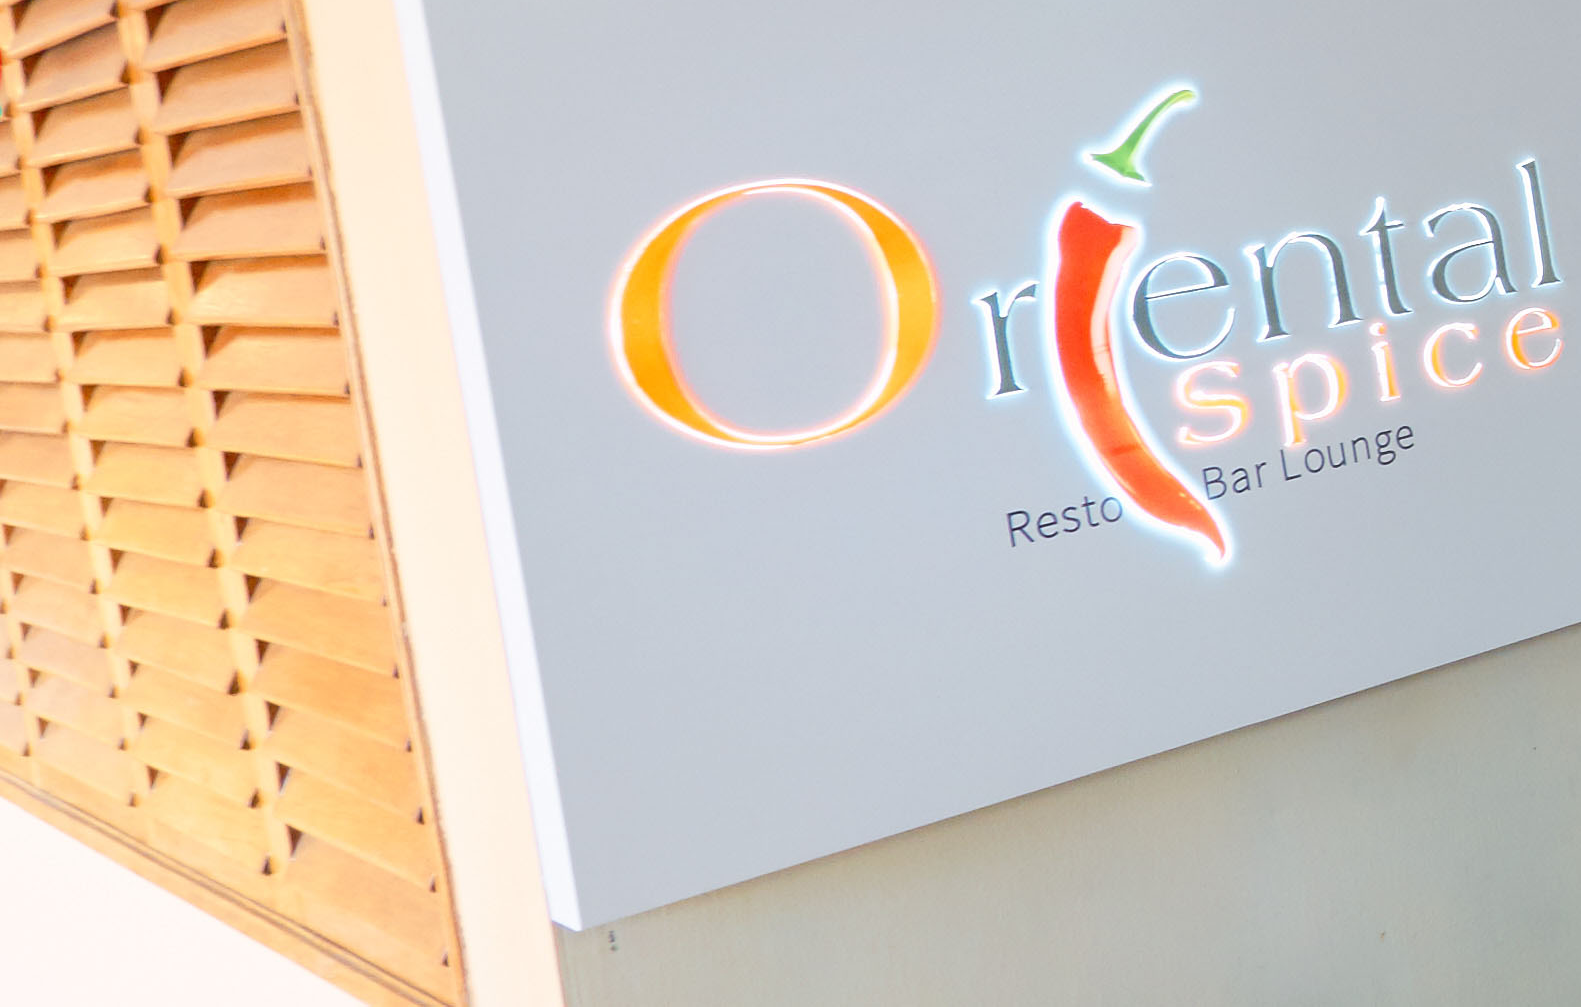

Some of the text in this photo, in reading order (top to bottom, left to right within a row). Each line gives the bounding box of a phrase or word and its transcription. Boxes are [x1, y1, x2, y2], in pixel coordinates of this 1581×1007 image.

[1176, 307, 1564, 448] spice
[1006, 424, 1416, 548] Resto Bar Lounge
